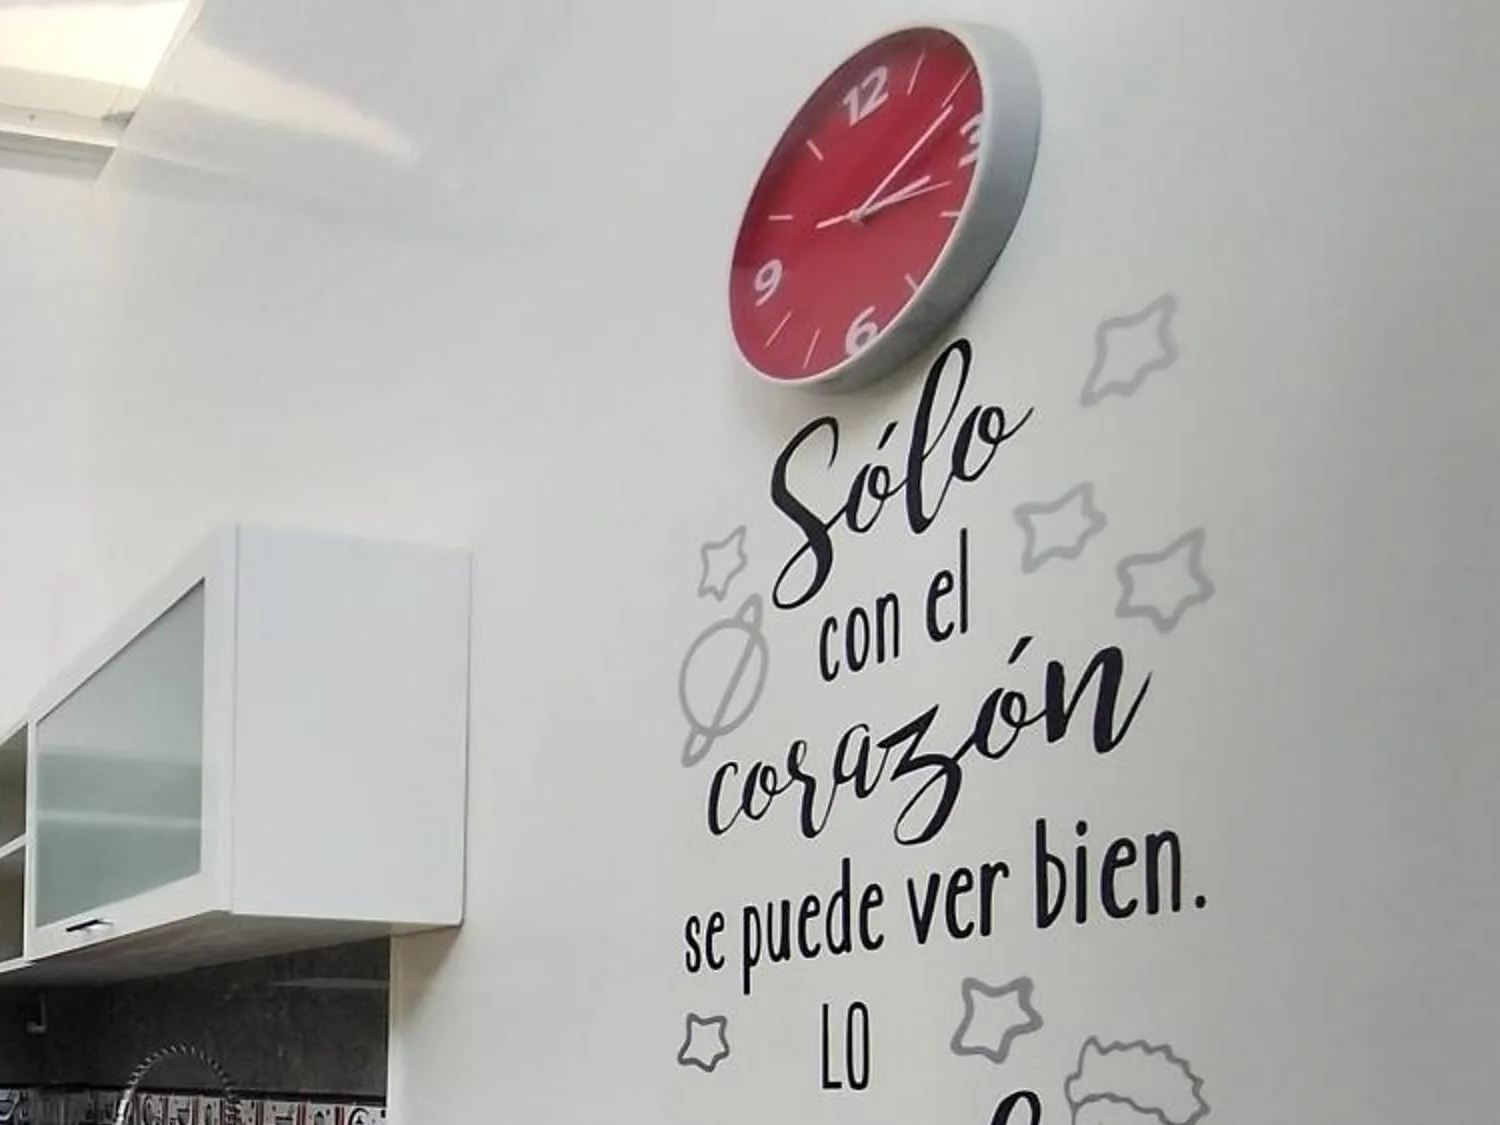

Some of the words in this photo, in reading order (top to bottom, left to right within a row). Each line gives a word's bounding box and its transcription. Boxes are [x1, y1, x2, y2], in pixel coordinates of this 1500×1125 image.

[842, 65, 889, 126] 12
[753, 259, 784, 306] 9
[845, 305, 881, 356] 6
[771, 337, 1034, 609] Sólo
[819, 592, 900, 682] con
[926, 527, 968, 642] el
[707, 636, 1152, 846] corazón
[685, 911, 725, 973] se
[743, 857, 885, 995] puede
[907, 861, 1010, 945] ver
[1035, 818, 1207, 929] bien.
[822, 1001, 870, 1090] LO
